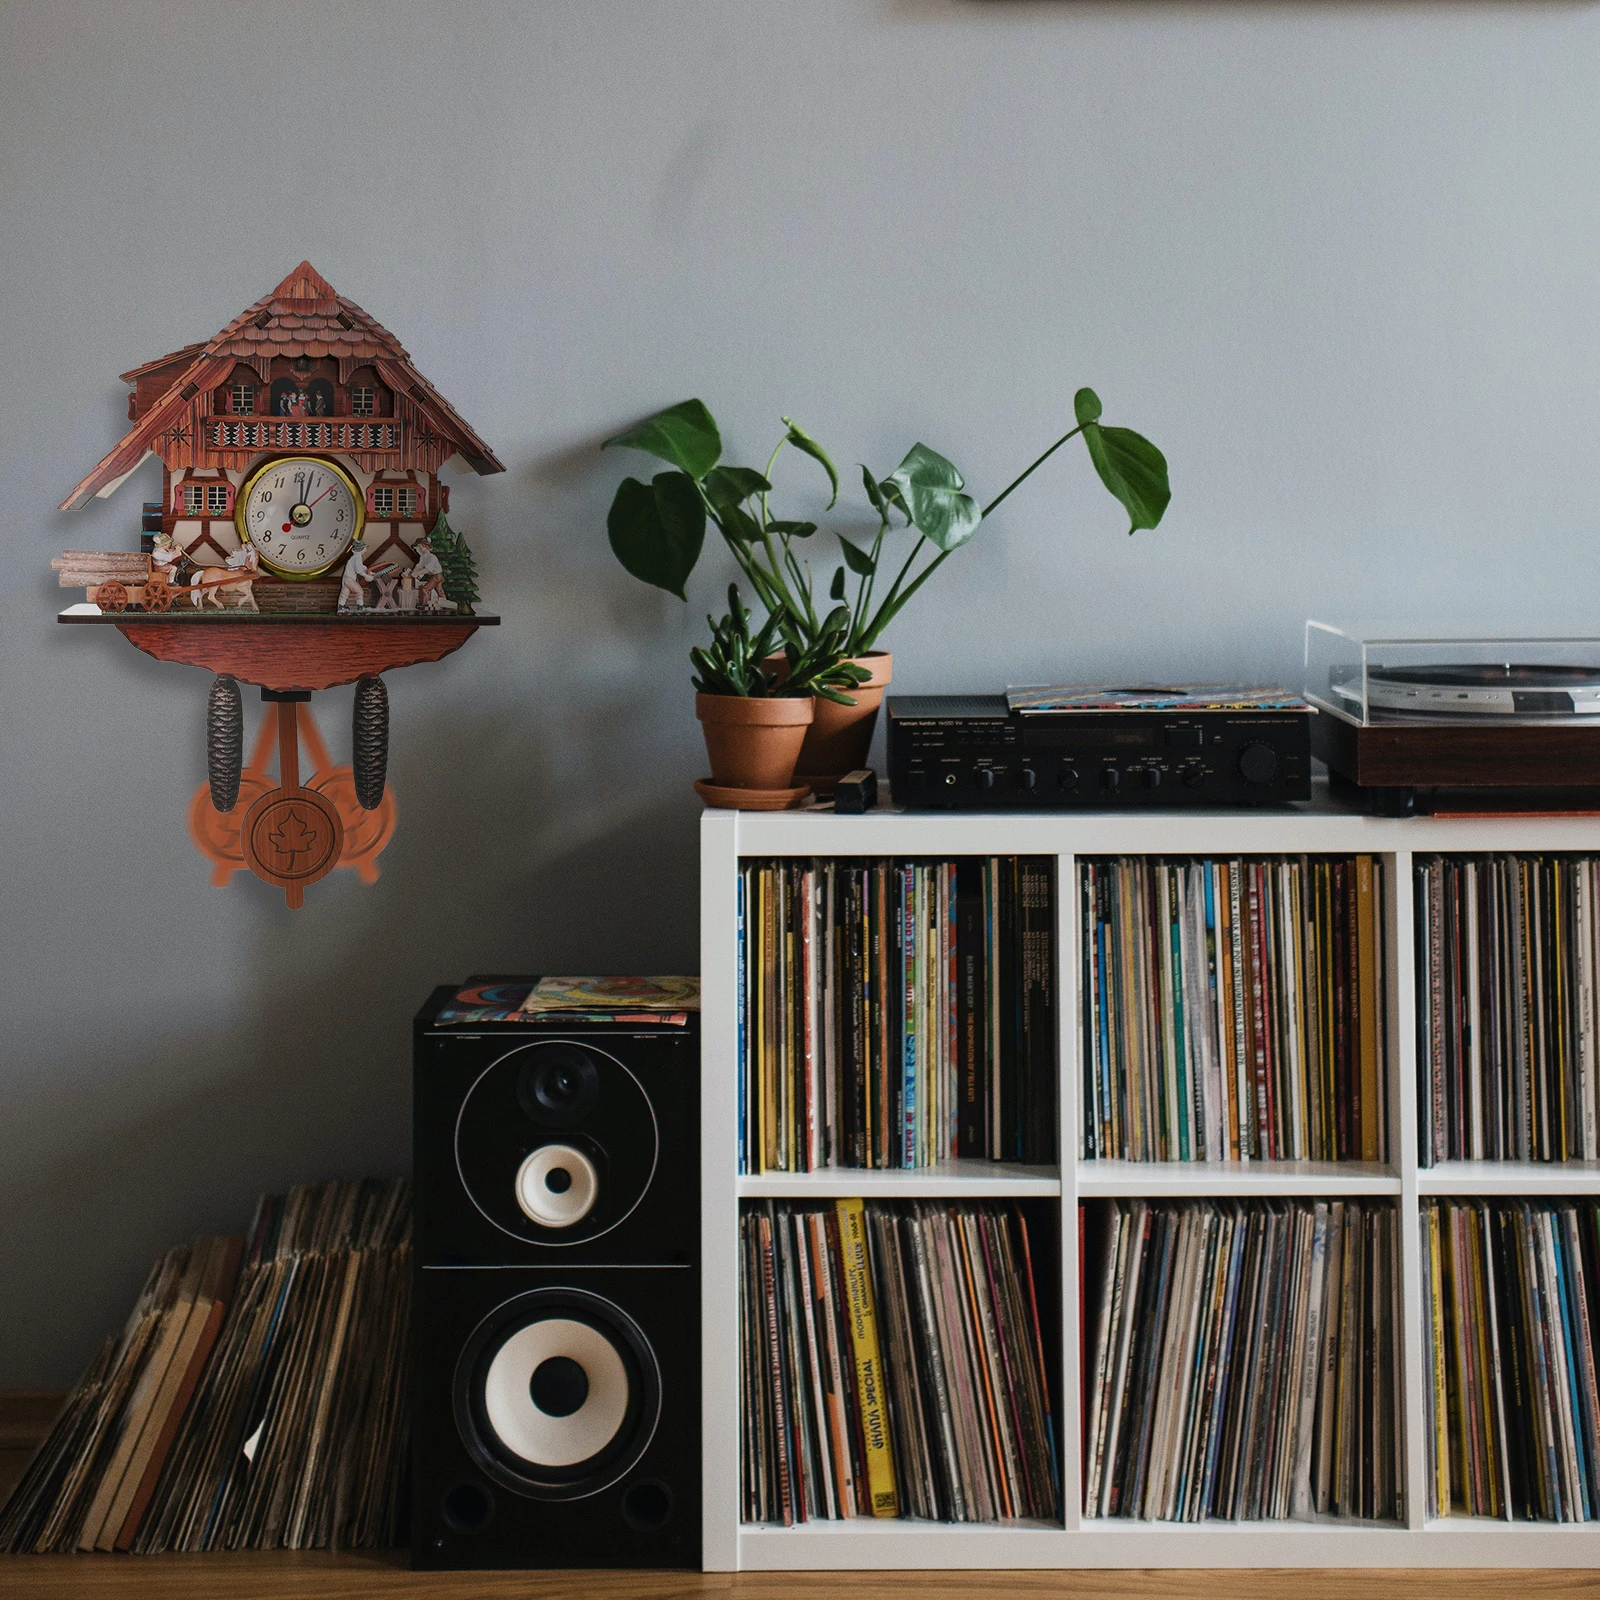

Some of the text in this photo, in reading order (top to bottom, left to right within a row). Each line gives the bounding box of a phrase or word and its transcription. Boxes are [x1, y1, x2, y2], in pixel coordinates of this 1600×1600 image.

[274, 477, 284, 488] 11
[294, 472, 306, 483] 12
[316, 477, 322, 488] 1
[260, 491, 272, 502] 10
[328, 490, 338, 502] 2
[257, 511, 265, 522] 9
[336, 509, 344, 522] 3
[262, 530, 272, 542] 8
[330, 528, 338, 540] 4
[278, 544, 287, 555] 7
[296, 549, 306, 560] 6
[316, 544, 324, 556] 5
[1230, 867, 1239, 901] PAKISTAN
[906, 868, 914, 936] BOLLYWOOD
[1232, 912, 1240, 930] FOLK
[1233, 951, 1241, 967] POP
[1234, 970, 1244, 1025] INSTRUMENTALS
[854, 1302, 865, 1339] MODERN
[865, 1359, 884, 1449] GHANA SPECIAL
